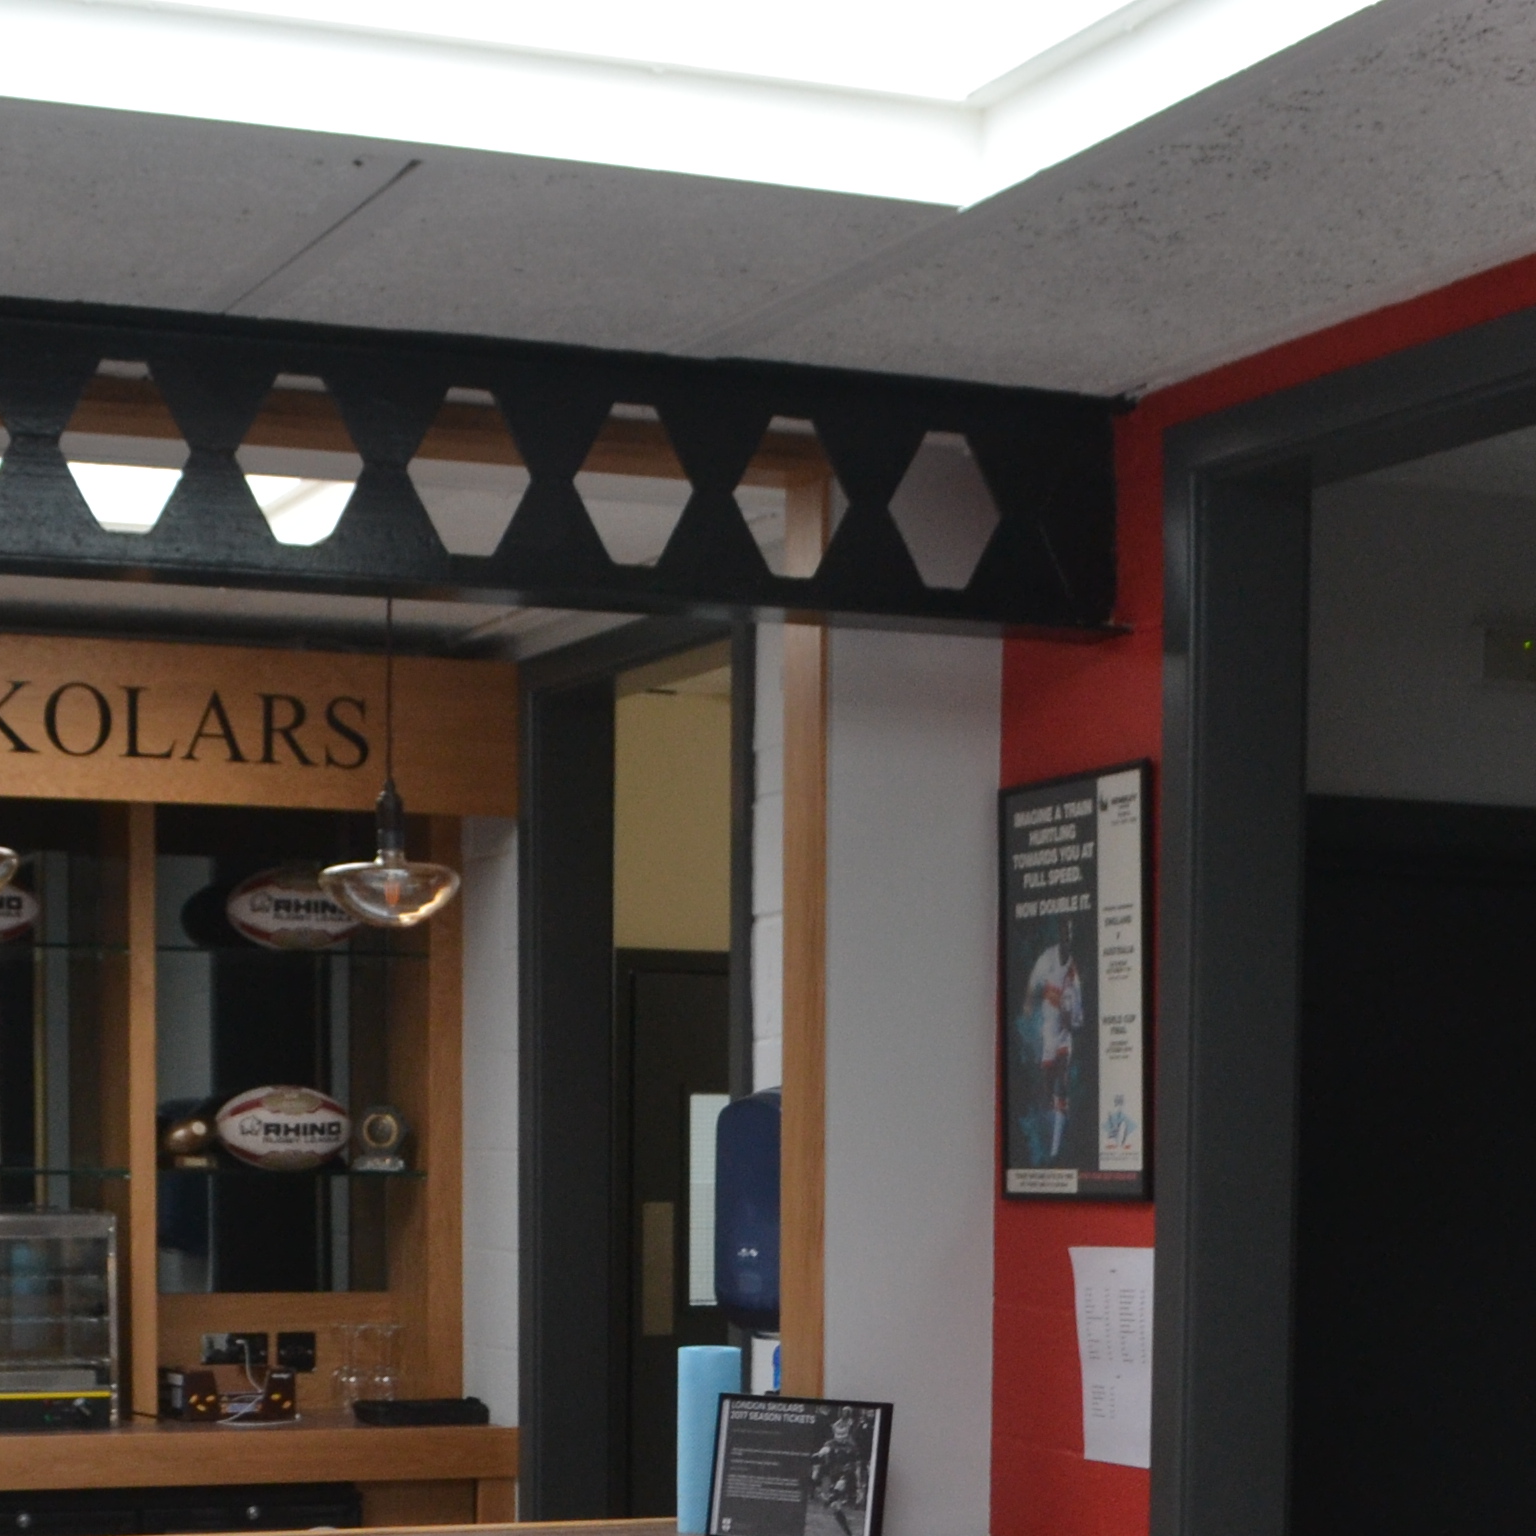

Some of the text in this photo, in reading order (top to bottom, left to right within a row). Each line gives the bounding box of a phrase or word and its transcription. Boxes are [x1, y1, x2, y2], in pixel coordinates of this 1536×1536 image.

[1012, 841, 1094, 870] TOWARDS YOU AT
[1023, 871, 1046, 889] FULL
[274, 899, 345, 913] RHIN
[1015, 901, 1038, 919] NOW
[264, 1121, 341, 1136] RHINO
[731, 1400, 804, 1413] LONDON SKOLARS
[730, 1410, 816, 1424] 2017 SEASON TICKETS
